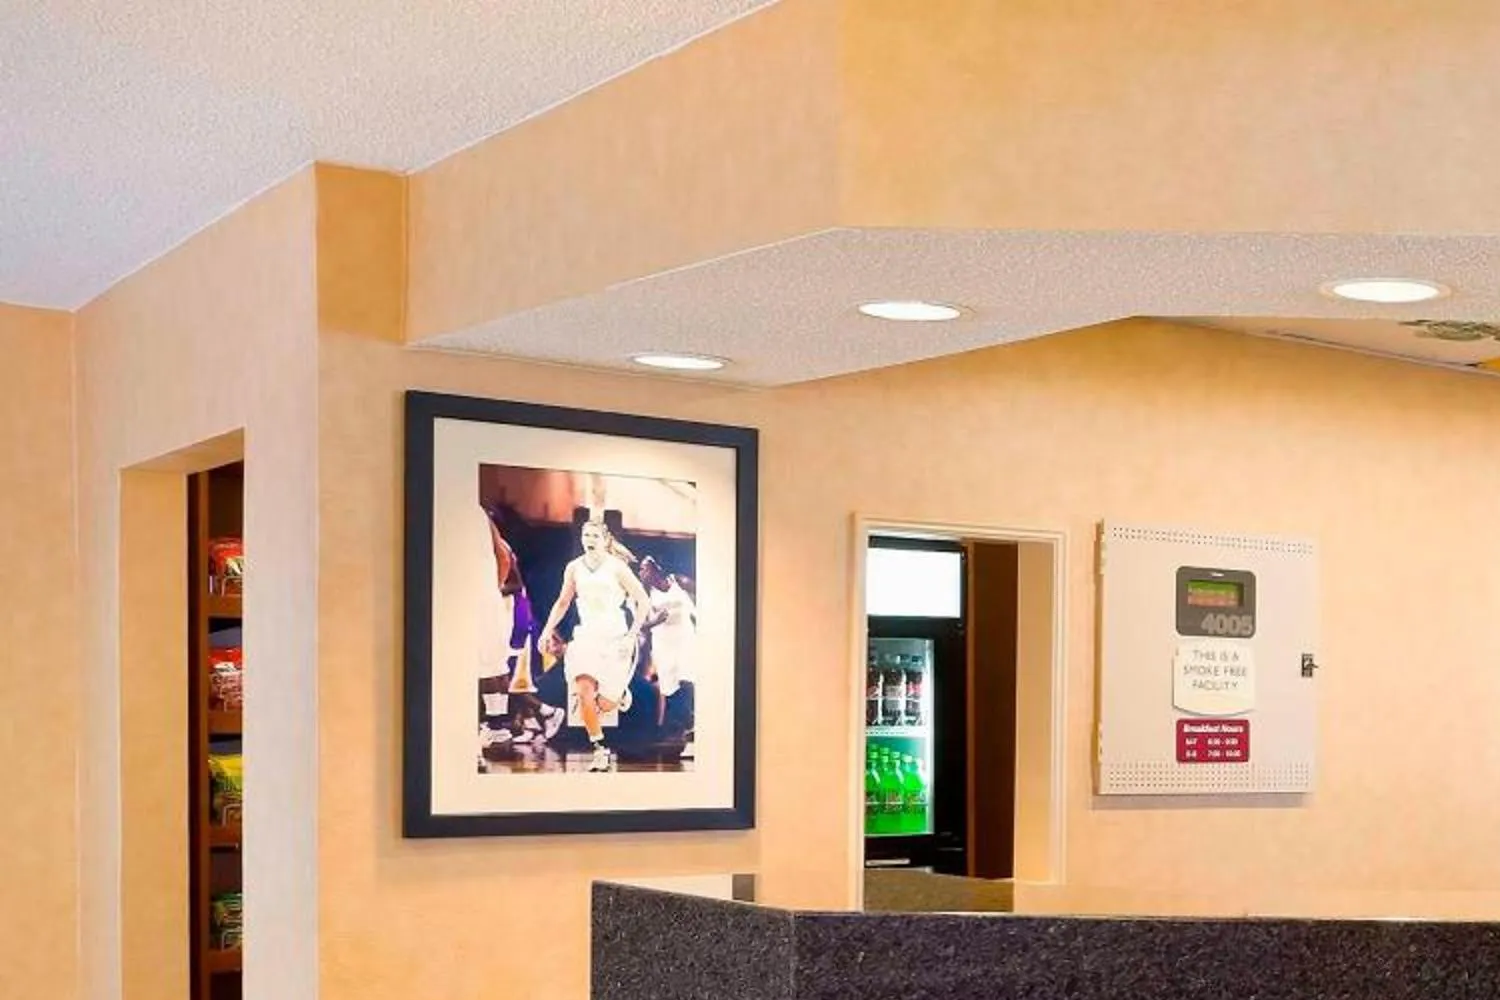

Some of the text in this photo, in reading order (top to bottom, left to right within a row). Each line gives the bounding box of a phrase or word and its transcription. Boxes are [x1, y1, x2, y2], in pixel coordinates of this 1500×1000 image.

[1201, 613, 1253, 636] 4005
[1193, 650, 1215, 661] THIS
[1183, 665, 1247, 677] SMOKE FREE
[1192, 680, 1239, 691] FACILITY
